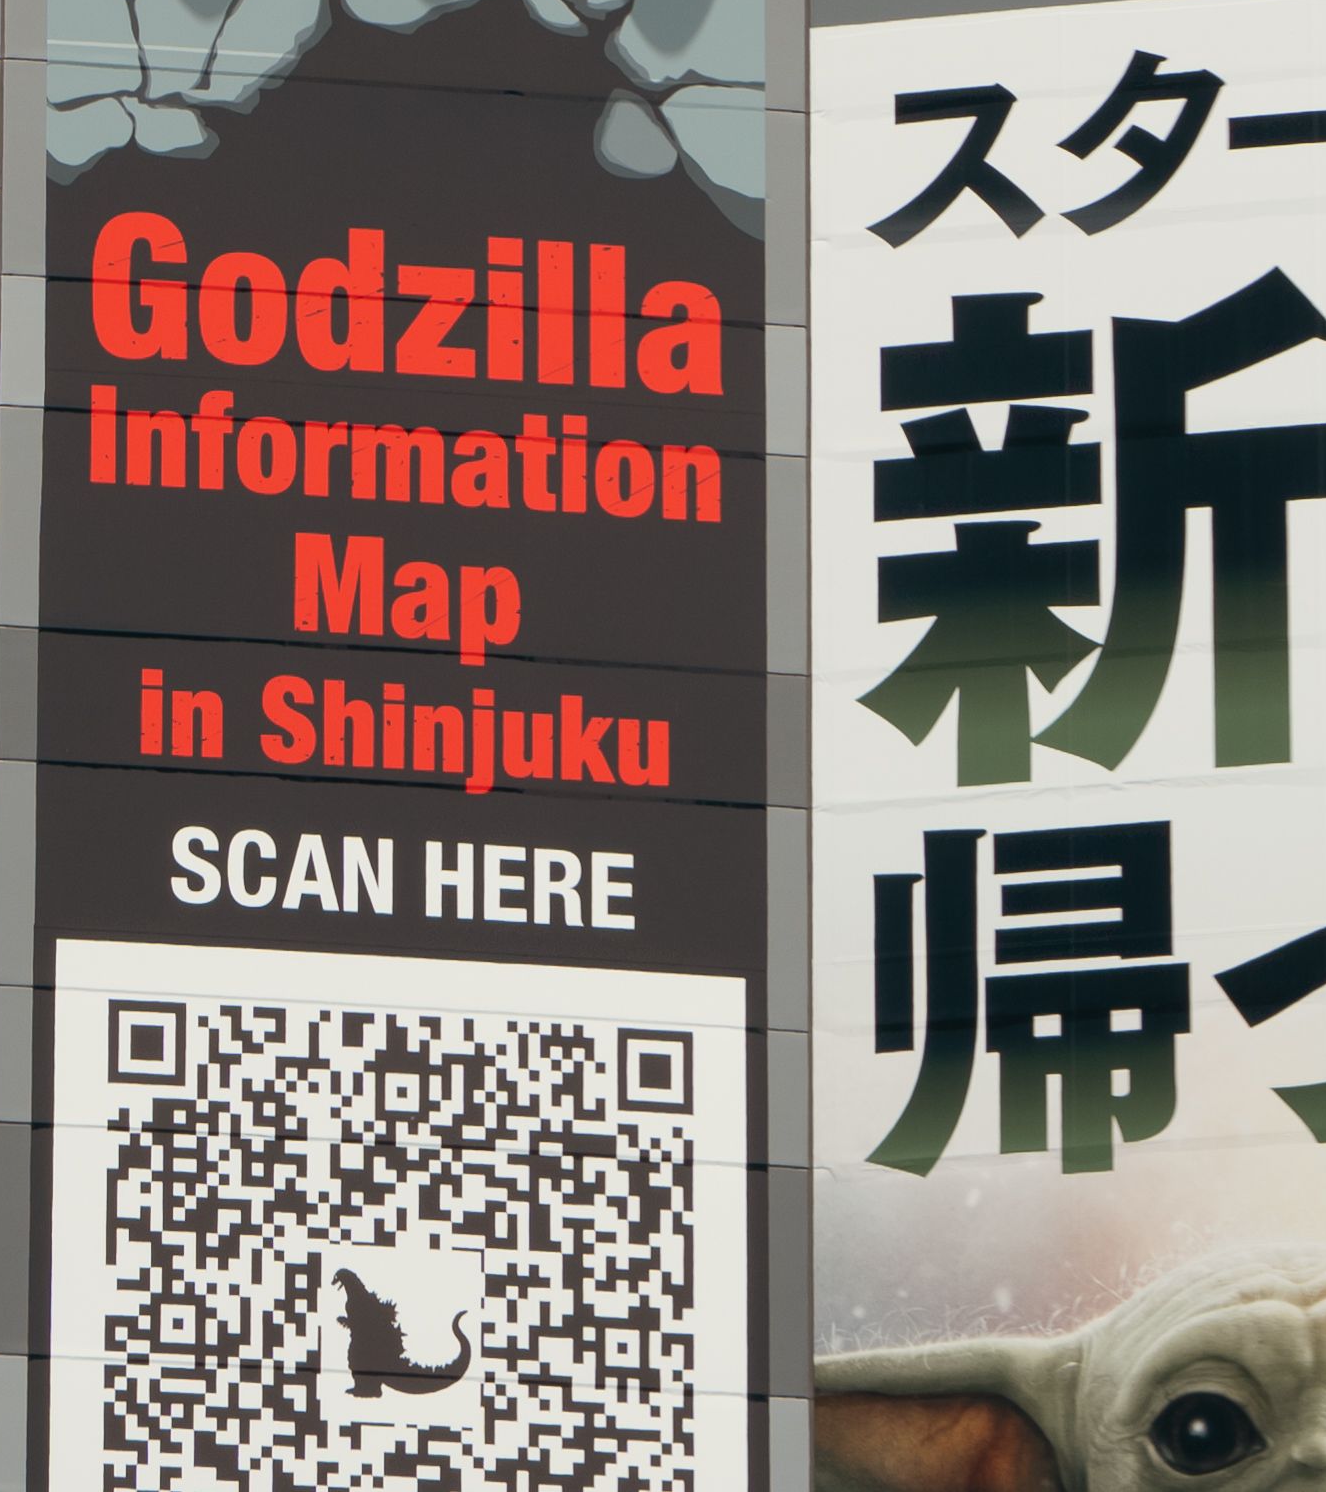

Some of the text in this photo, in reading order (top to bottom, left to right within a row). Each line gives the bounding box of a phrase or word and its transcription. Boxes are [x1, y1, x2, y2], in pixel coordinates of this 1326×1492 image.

[90, 211, 724, 396] Godzilla
[89, 384, 723, 523] Information
[293, 532, 522, 667] Map
[140, 668, 671, 795] in Shinjuku
[170, 826, 637, 930] SCAN HERE
